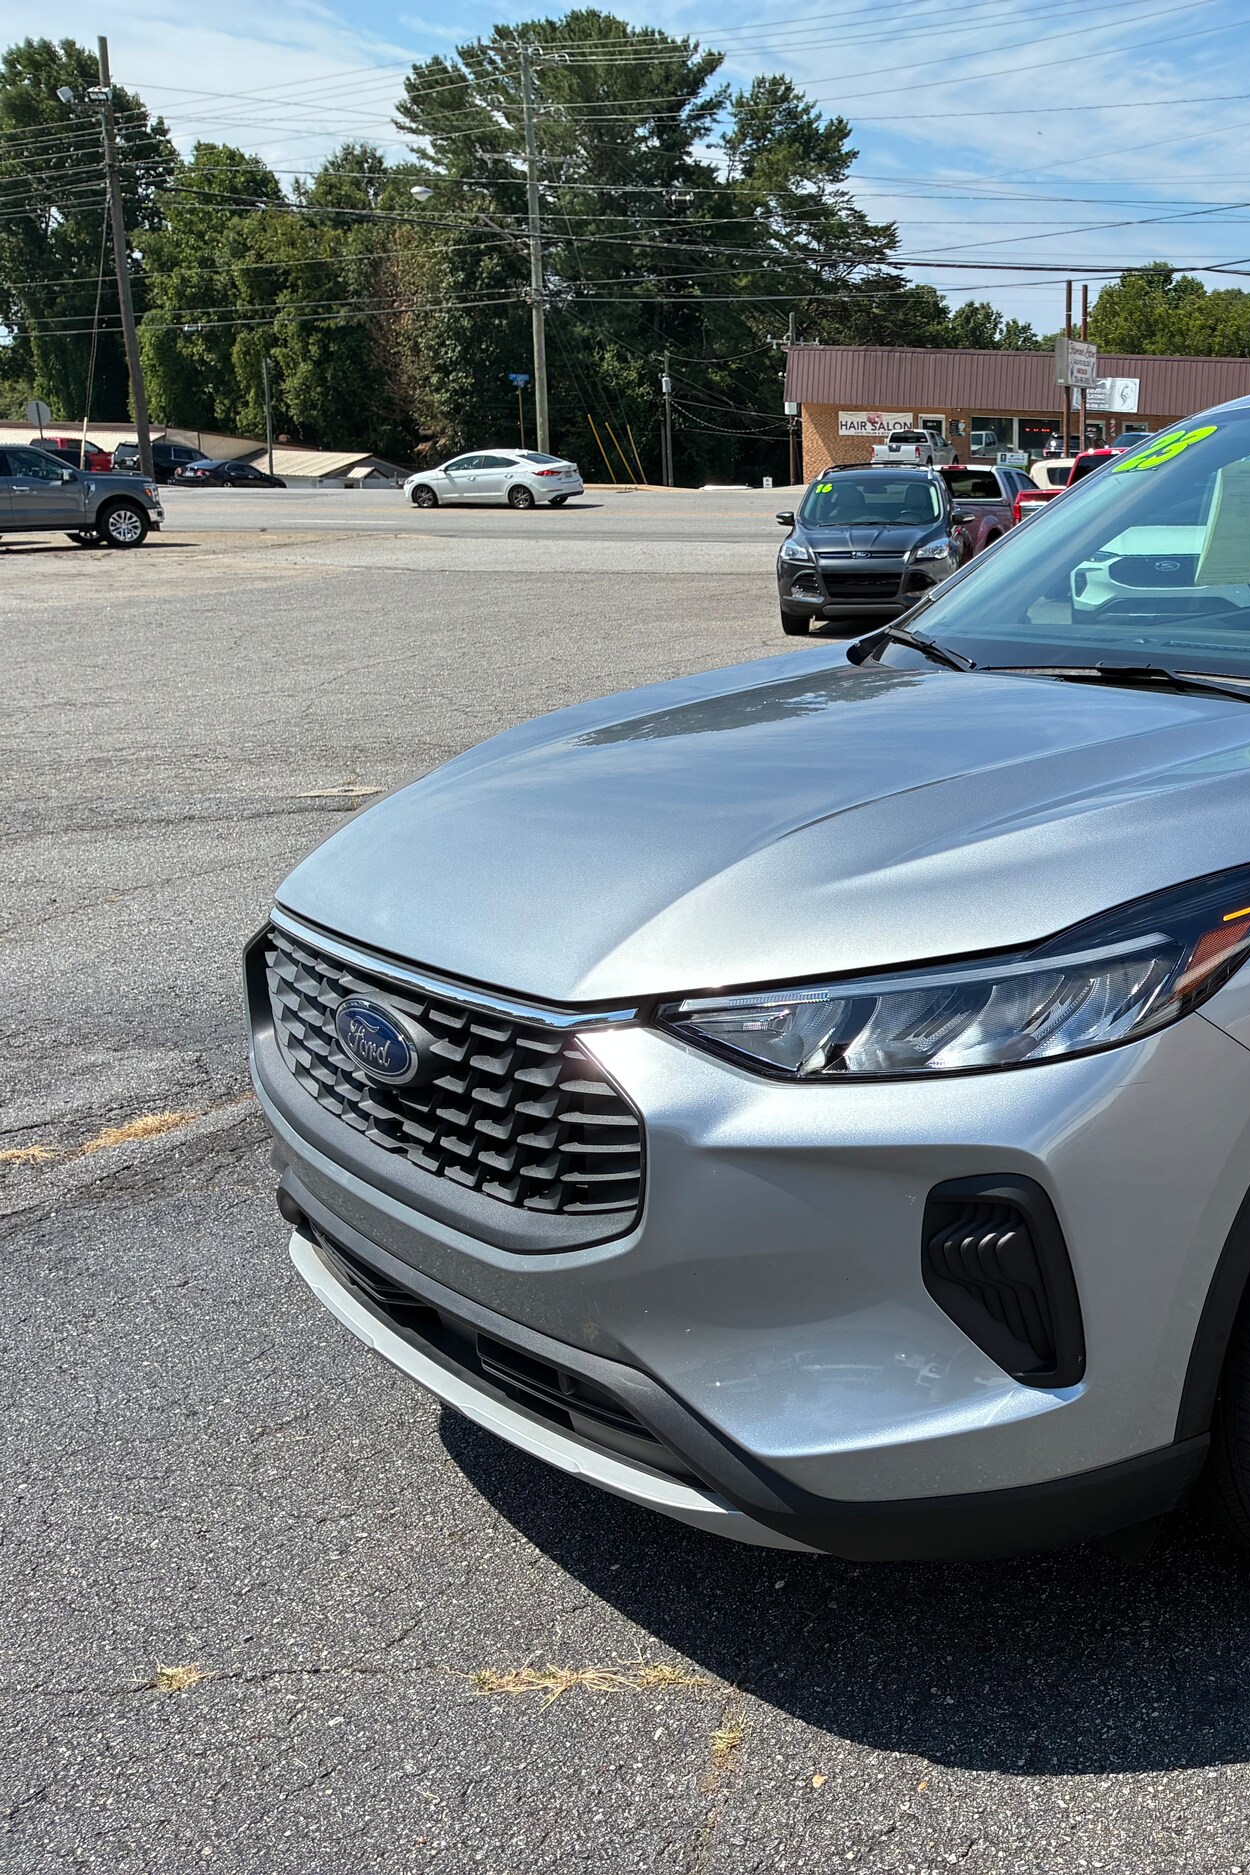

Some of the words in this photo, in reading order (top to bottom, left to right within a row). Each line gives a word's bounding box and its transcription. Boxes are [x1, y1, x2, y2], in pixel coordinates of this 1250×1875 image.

[840, 420, 867, 431] HAIR
[870, 421, 913, 432] SALON
[1112, 425, 1218, 473] 23
[815, 483, 833, 494] 16
[347, 1015, 391, 1068] Ford
